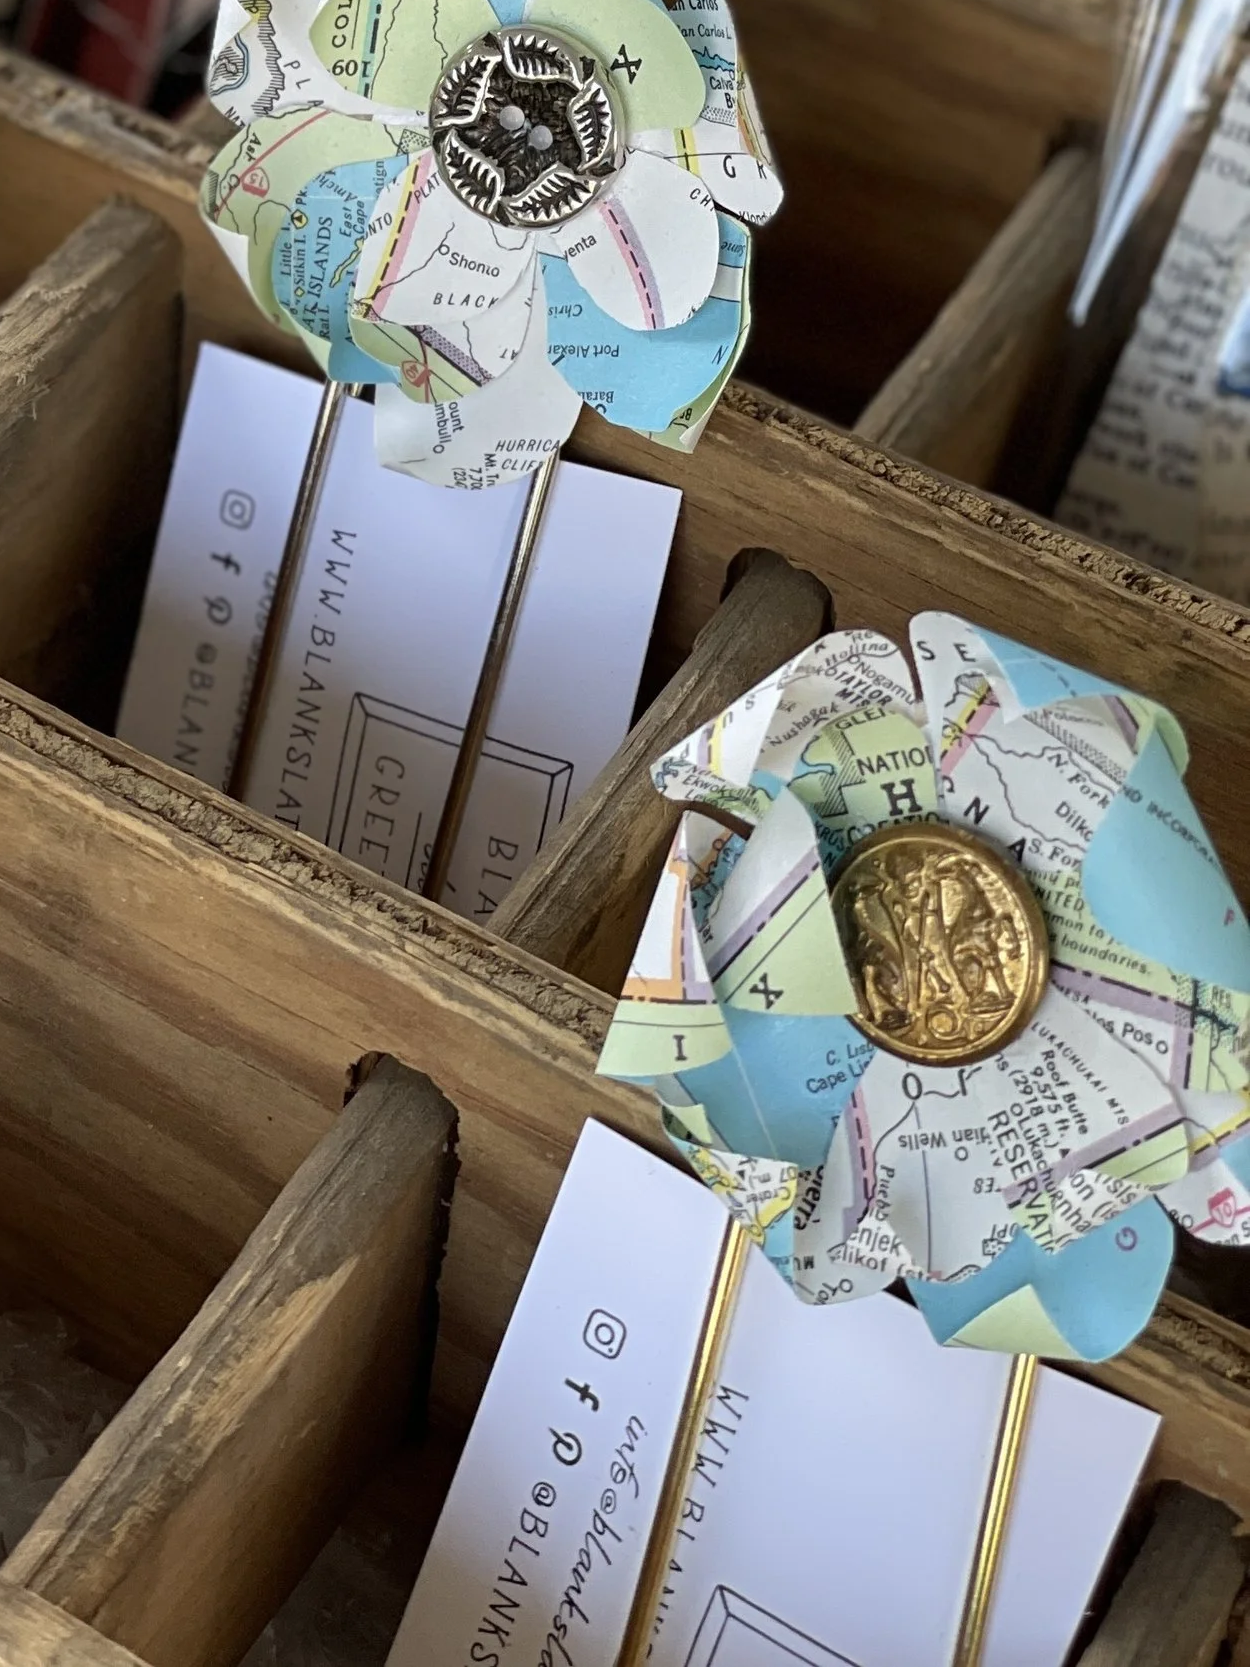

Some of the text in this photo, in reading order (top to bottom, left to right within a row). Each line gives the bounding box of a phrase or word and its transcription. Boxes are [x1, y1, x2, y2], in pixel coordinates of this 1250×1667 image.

[308, 215, 334, 304] ISLANDS
[592, 343, 620, 358] Port
[805, 1069, 847, 1094] Cape
